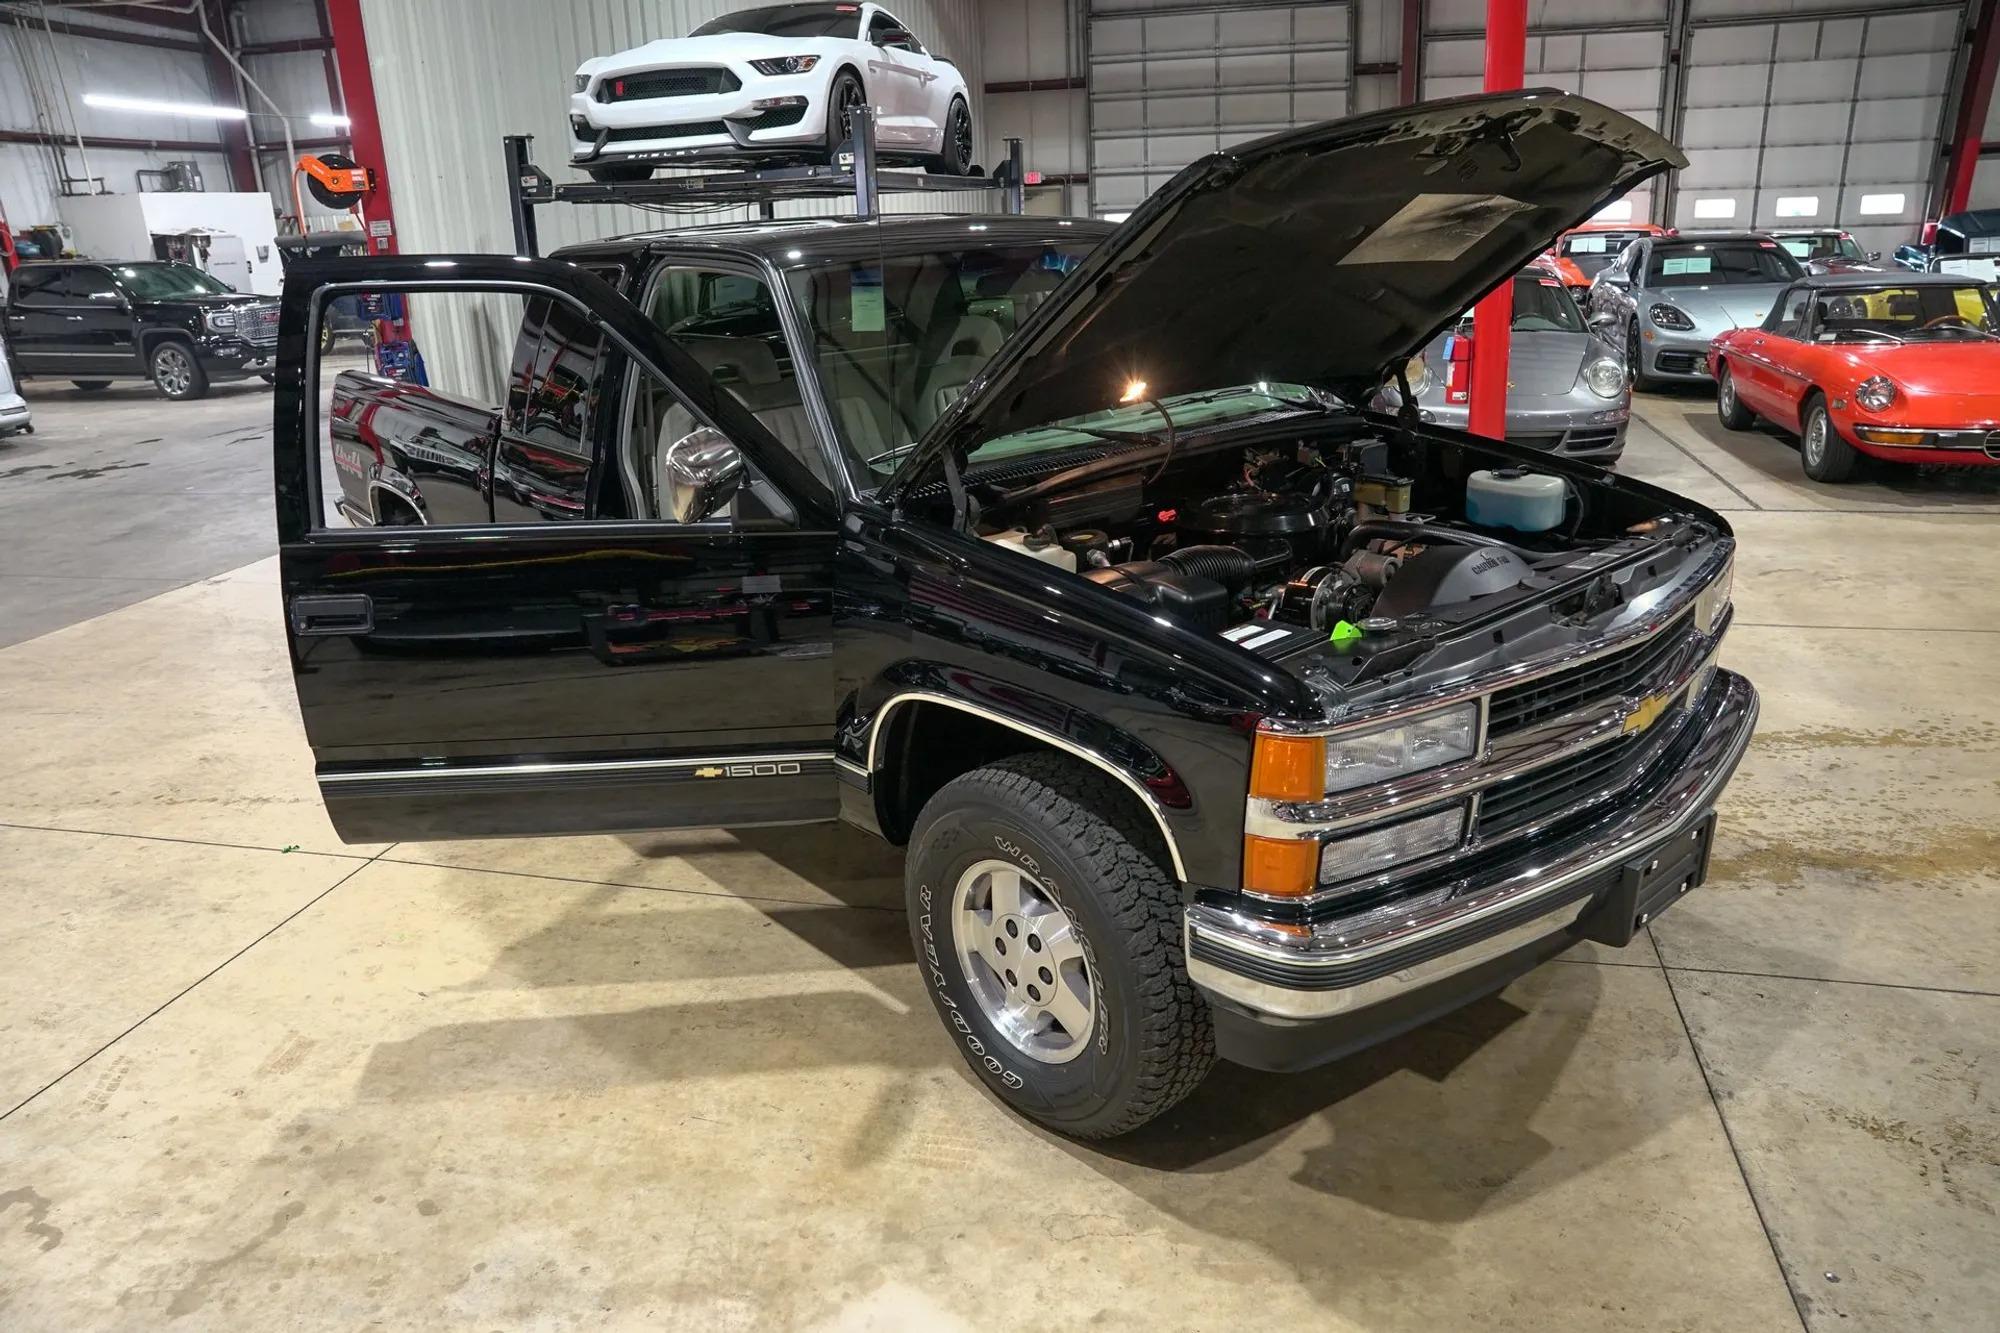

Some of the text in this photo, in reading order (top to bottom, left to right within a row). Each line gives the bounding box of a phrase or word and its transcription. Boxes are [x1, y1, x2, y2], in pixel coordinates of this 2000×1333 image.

[627, 149, 700, 160] SHELBY
[1471, 559, 1499, 575] CAUTION
[725, 762, 800, 777] 1500
[919, 884, 1024, 1090] GOODYEAR
